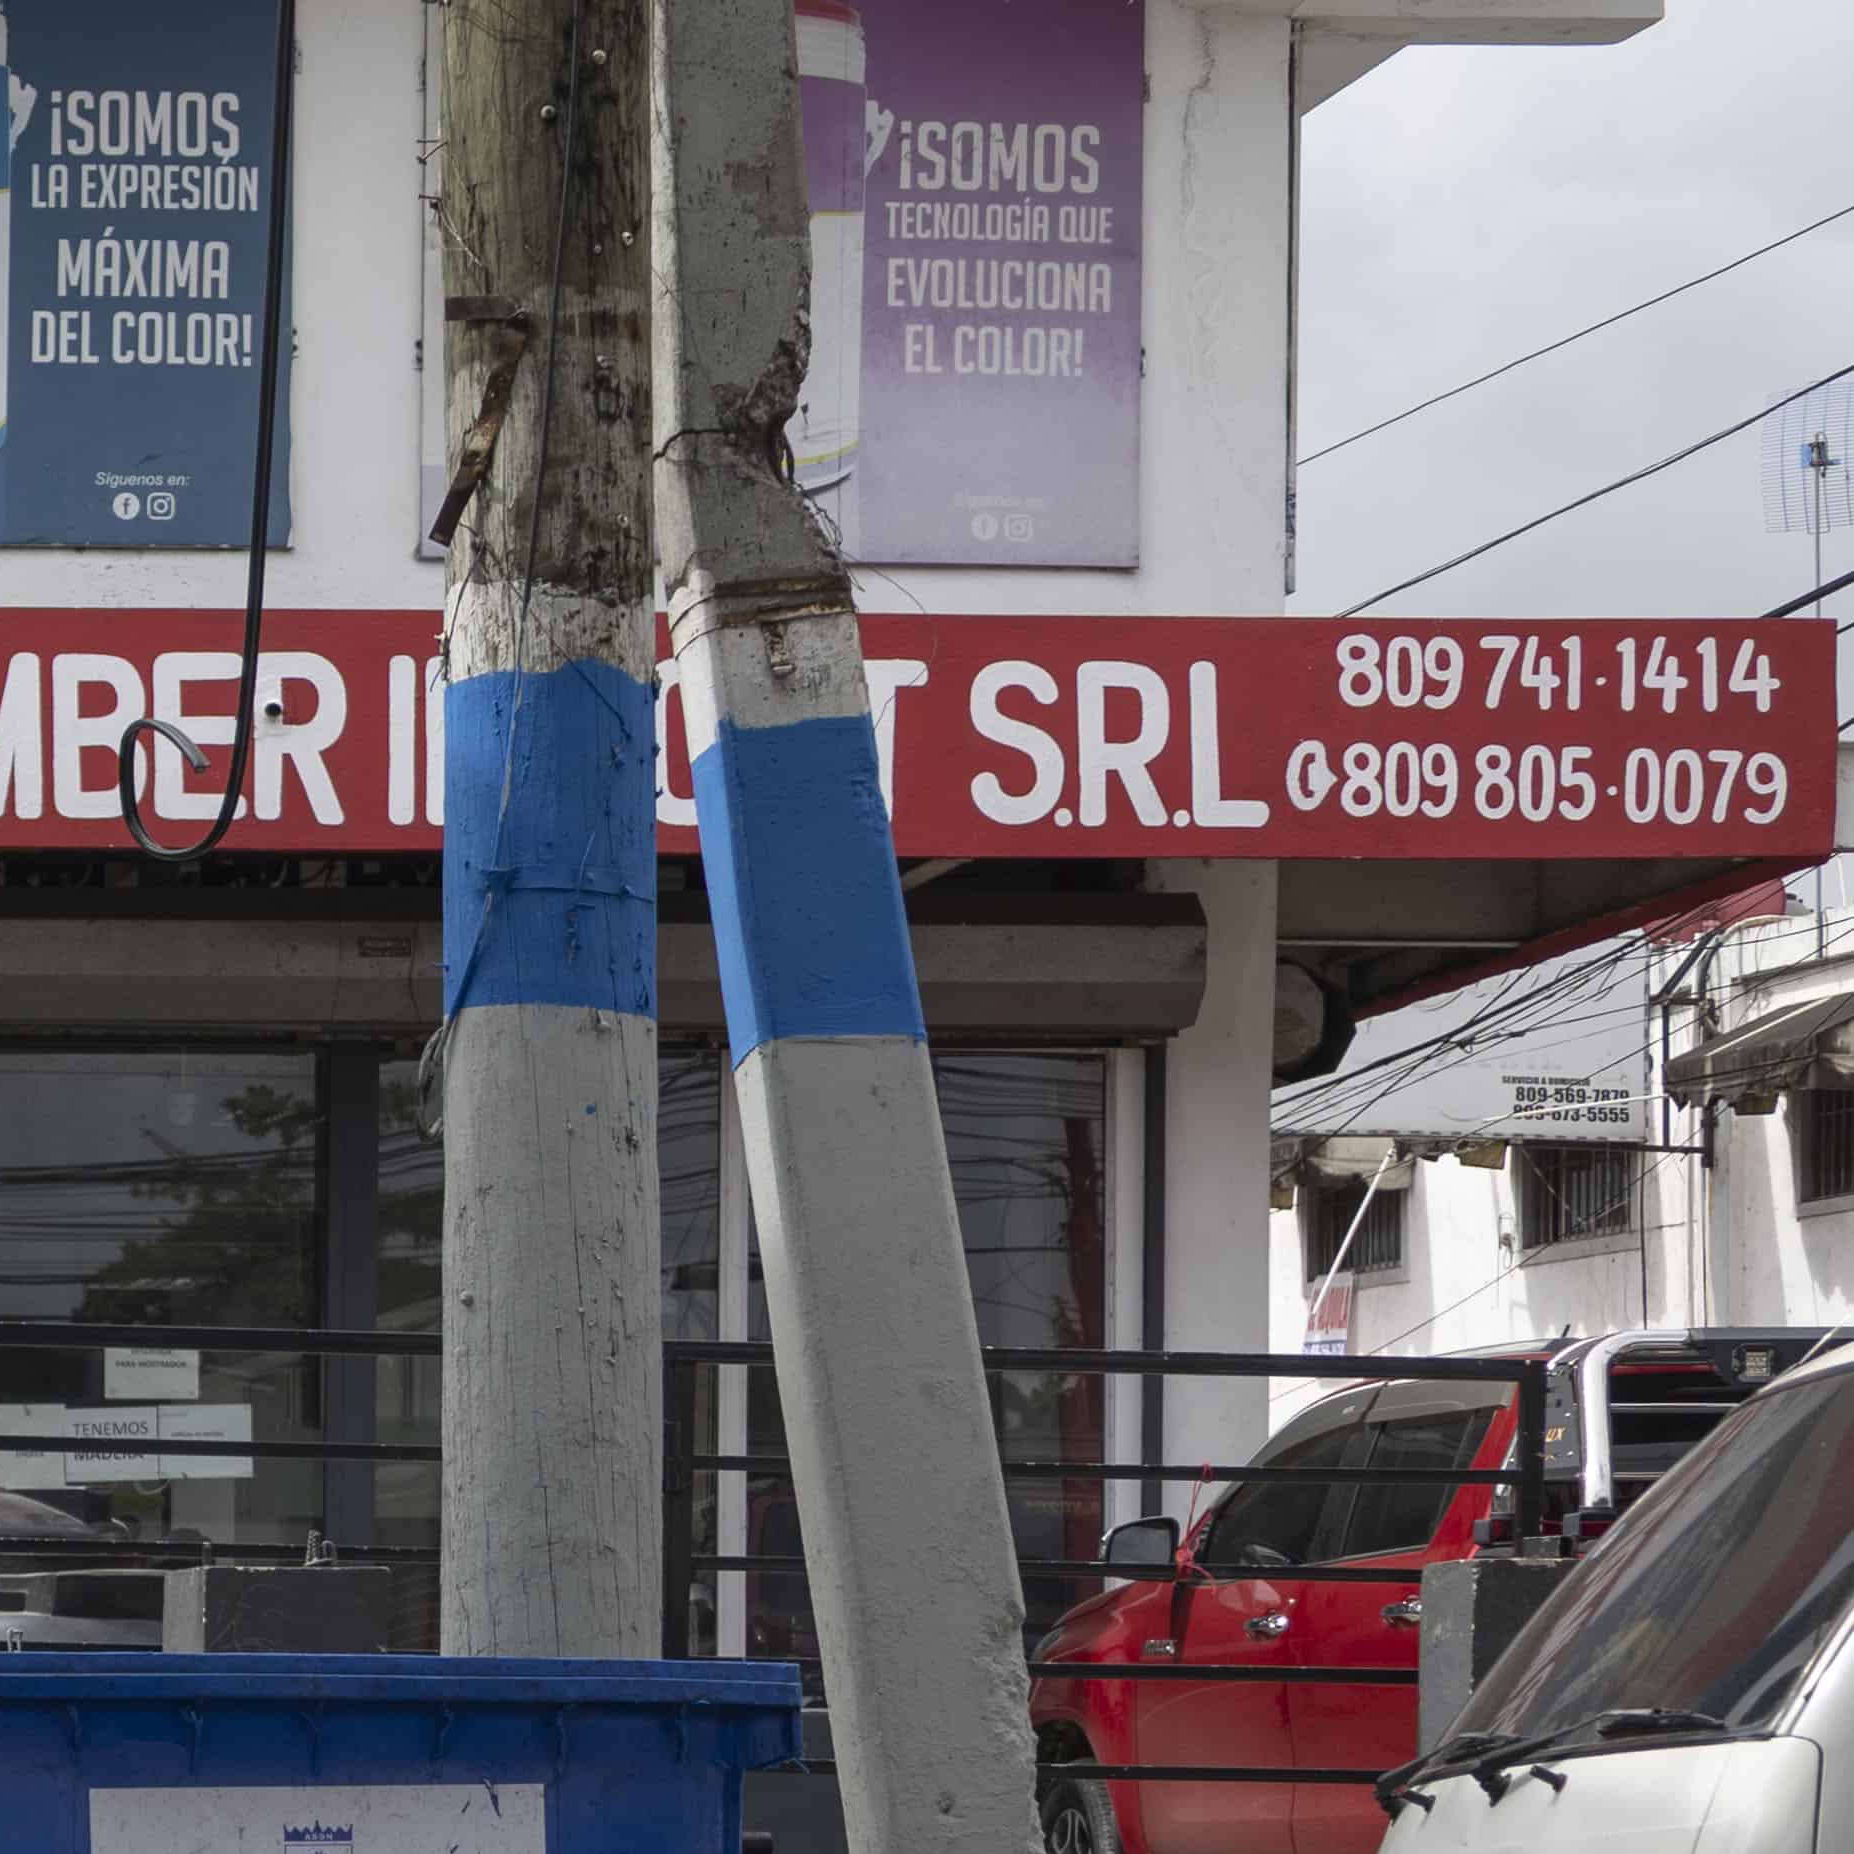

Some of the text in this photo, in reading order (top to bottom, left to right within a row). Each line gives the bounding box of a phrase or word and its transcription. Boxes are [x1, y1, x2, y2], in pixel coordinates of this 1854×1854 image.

[51, 91, 241, 158] ¡SOMOS
[32, 155, 260, 211] LA EXPRESIÓN
[899, 120, 1100, 193] ¡SOMOS
[886, 198, 1112, 243] TECNOLOGÍA QUE
[57, 226, 230, 299] MÁXIMA
[887, 257, 1112, 312] EVOLUCIONA
[31, 310, 253, 367] DEL COLOR!
[904, 324, 1084, 377] EL COLOR!
[1336, 633, 1465, 710] 809
[1340, 740, 1459, 819] 809
[72, 1419, 149, 1438] TENEMOS
